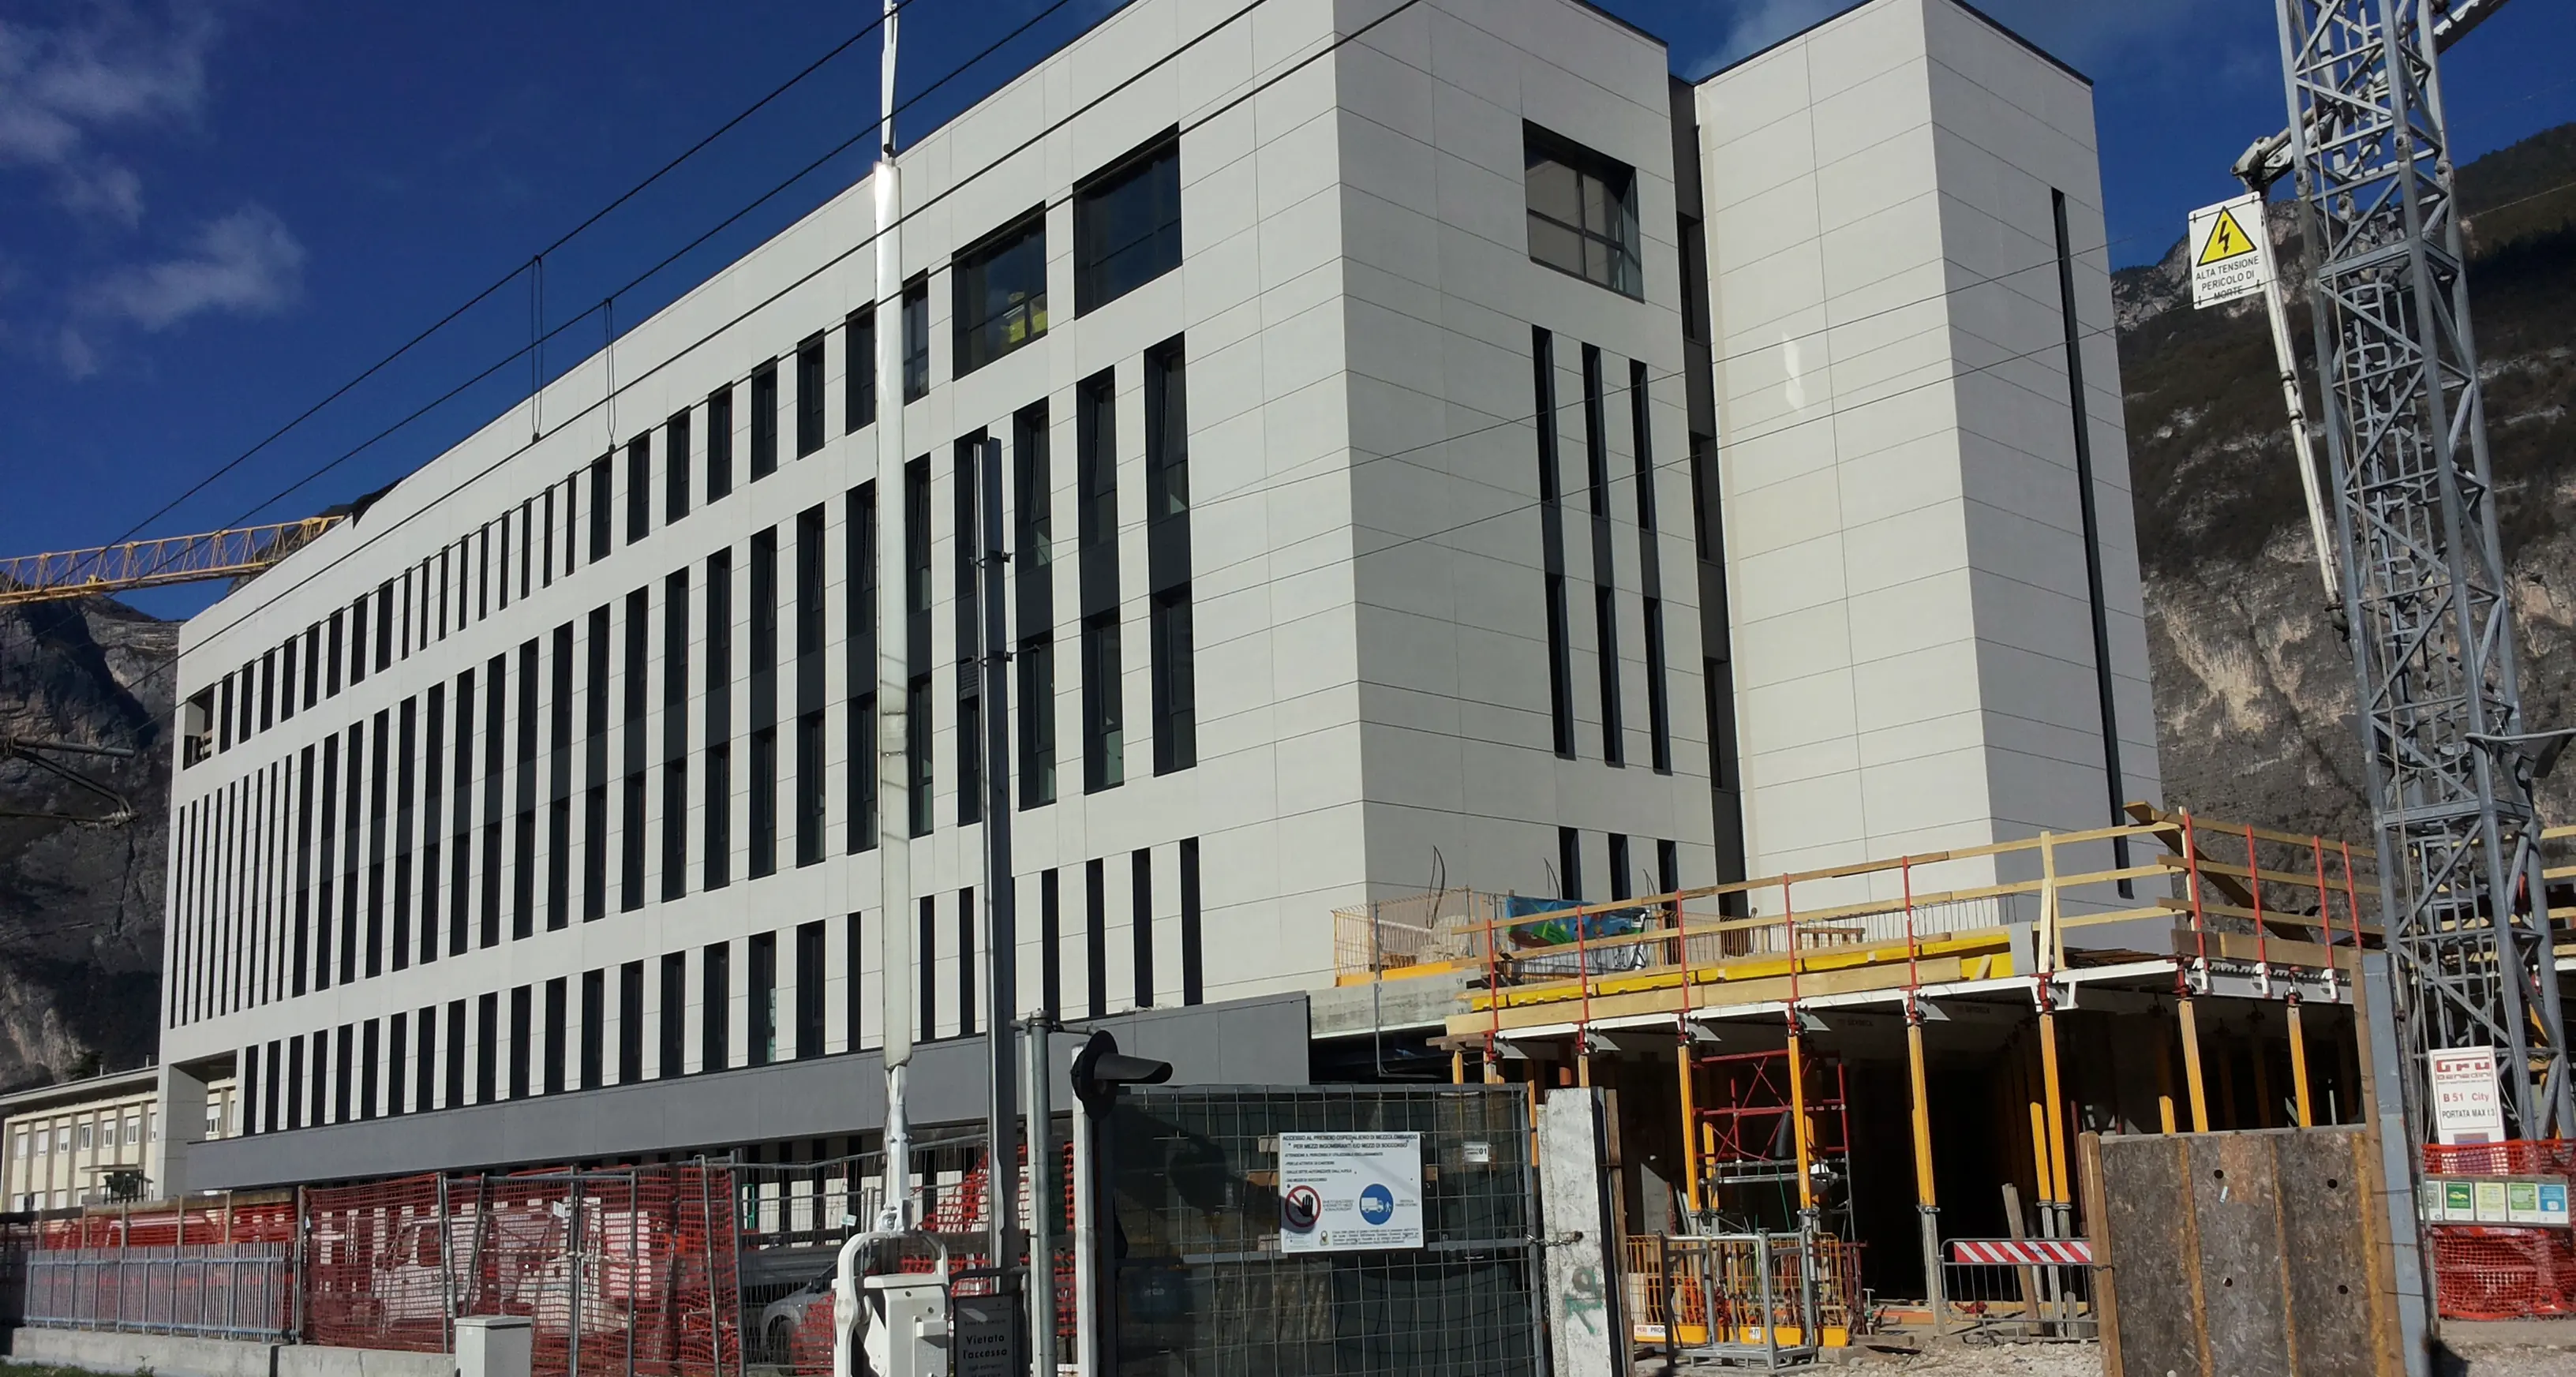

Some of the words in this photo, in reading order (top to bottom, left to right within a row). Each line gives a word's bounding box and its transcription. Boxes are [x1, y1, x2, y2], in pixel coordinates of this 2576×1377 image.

[2196, 268, 2216, 281] ALTA
[2218, 255, 2260, 275] TENSIONE
[2201, 272, 2245, 292] PERICOLO
[2245, 270, 2255, 279] DI
[2214, 285, 2243, 300] MORTE
[2443, 1093, 2450, 1102] B
[2452, 1092, 2463, 1102] 51
[2471, 1092, 2489, 1102] City
[2442, 1109, 2470, 1119] PORTATA
[966, 1334, 1005, 1345] Vietato
